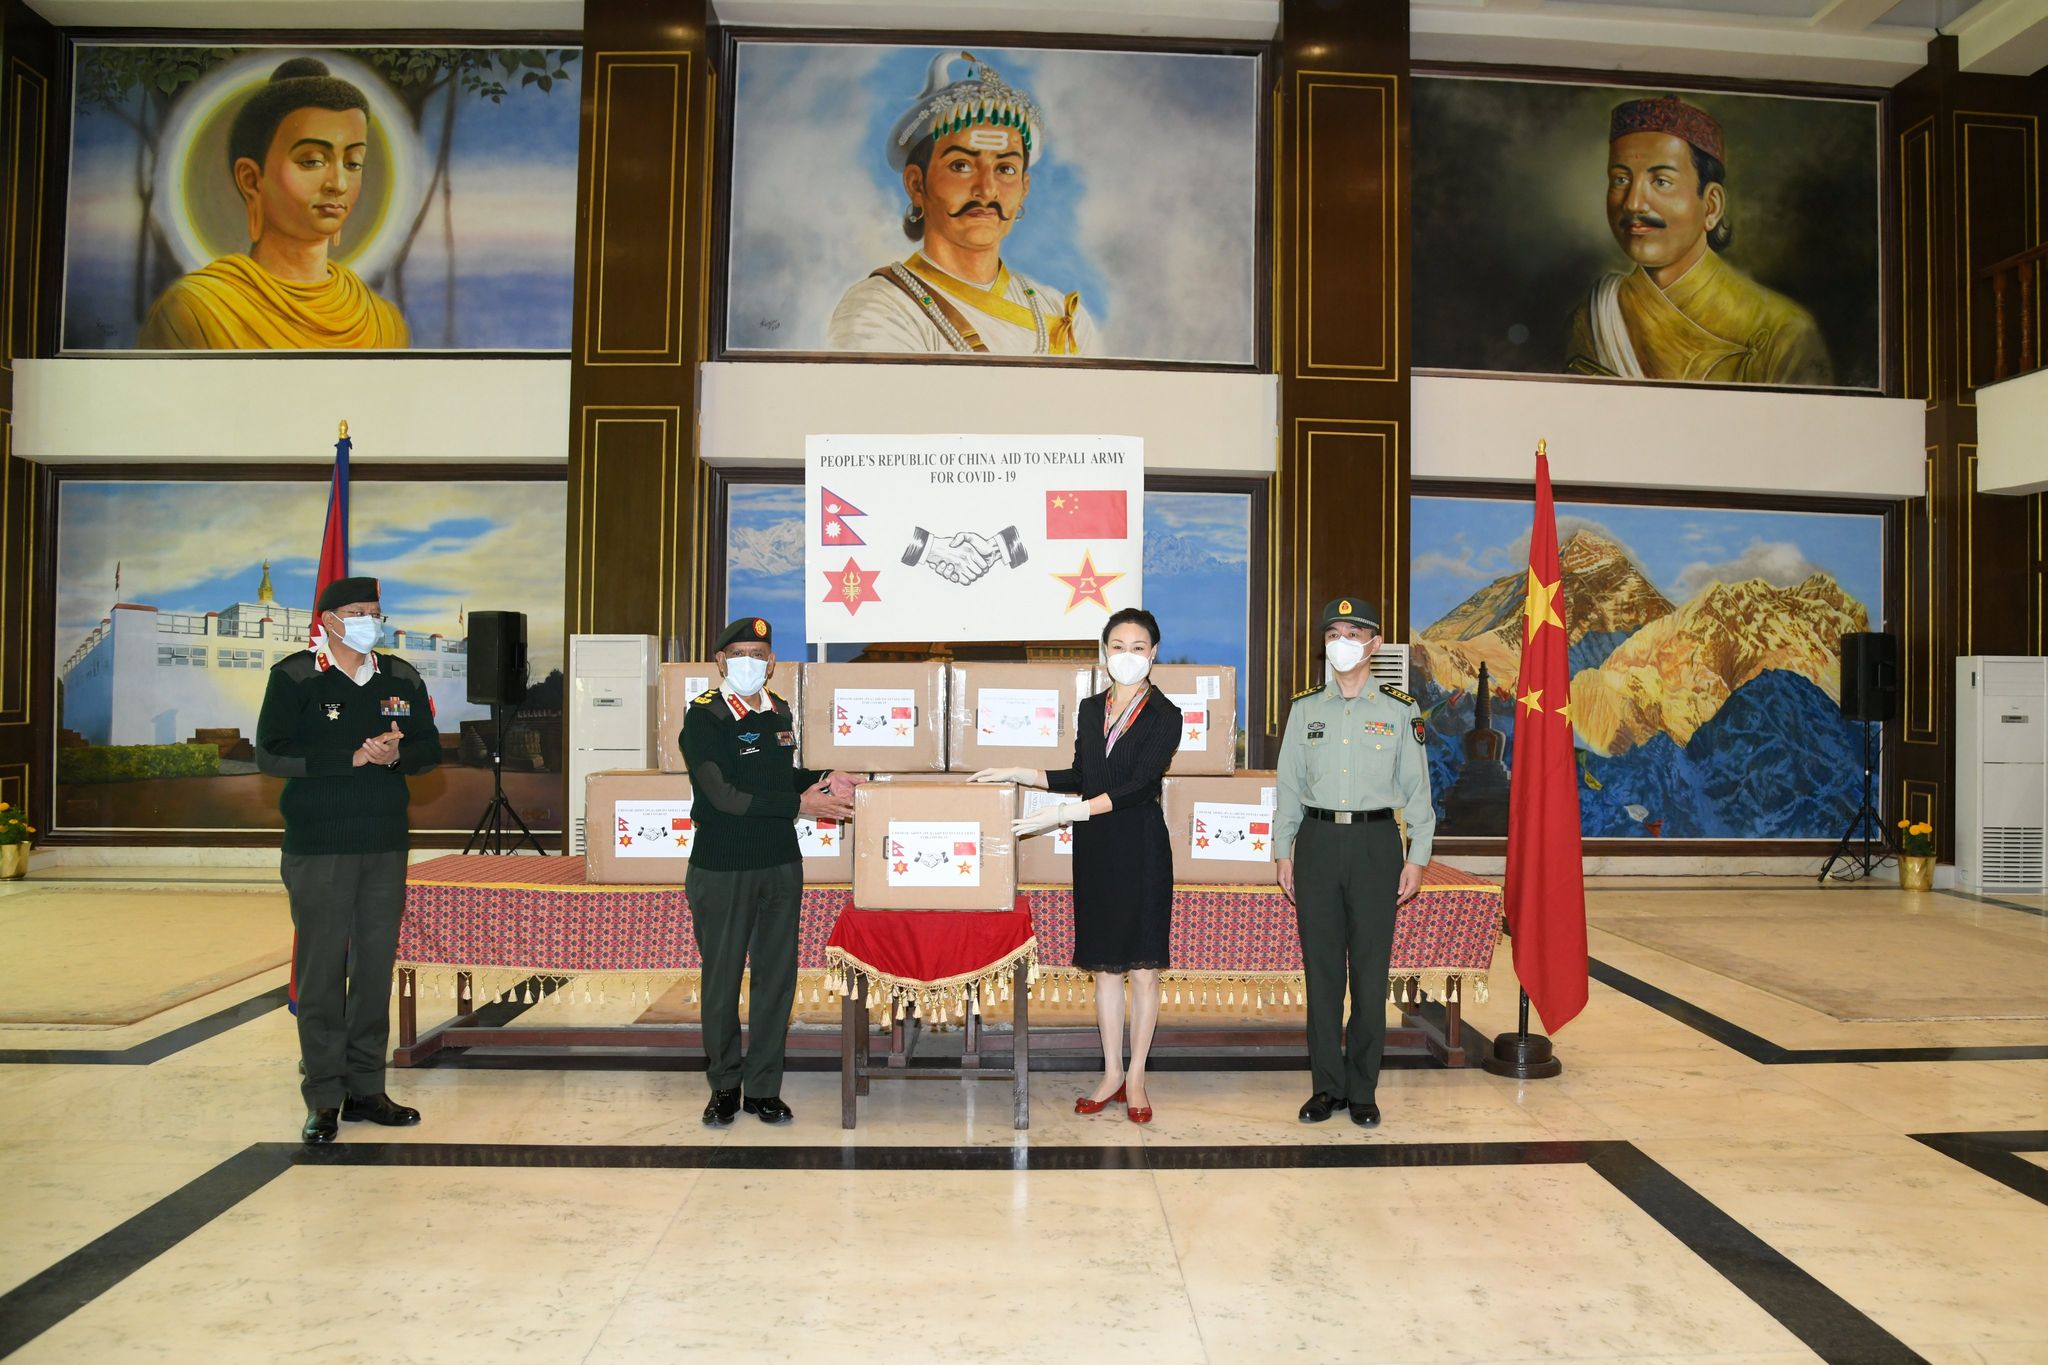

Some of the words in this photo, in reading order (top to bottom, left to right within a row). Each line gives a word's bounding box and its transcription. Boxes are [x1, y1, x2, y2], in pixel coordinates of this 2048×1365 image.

[820, 454, 876, 467] PEOPLE'S
[878, 453, 937, 467] REPUBLIC
[939, 453, 956, 466] OF
[958, 453, 996, 466] CHINA
[1000, 452, 1022, 465] AID
[1024, 452, 1041, 465] TO
[1043, 452, 1086, 465] NEPALI
[1090, 452, 1126, 464] ARMY
[930, 471, 955, 484] FOR
[957, 470, 995, 484] COVID
[1005, 470, 1017, 483] 19
